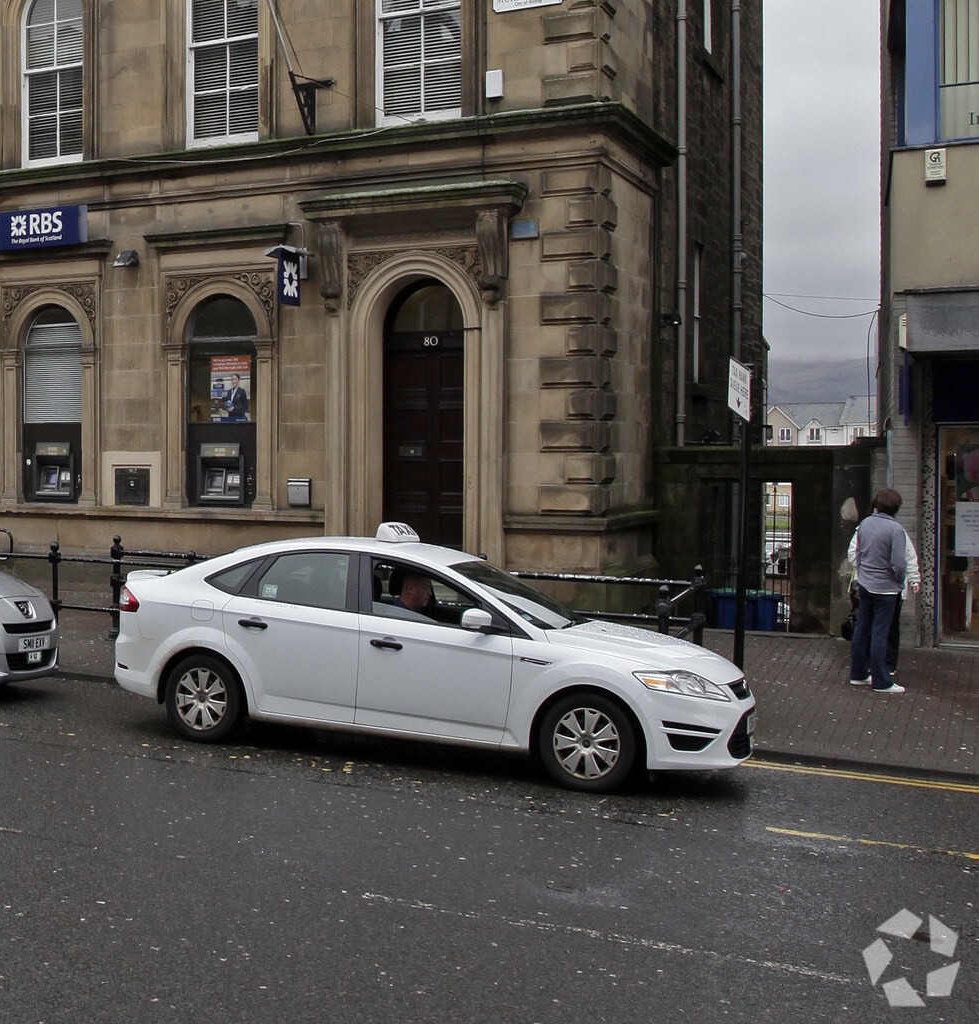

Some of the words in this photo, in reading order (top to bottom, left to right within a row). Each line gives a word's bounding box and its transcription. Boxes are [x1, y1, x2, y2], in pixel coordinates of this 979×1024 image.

[29, 211, 63, 235] RBS
[19, 237, 29, 245] Royal
[44, 234, 63, 242] Scotland
[423, 335, 439, 347] 80
[388, 524, 417, 537] TAXI
